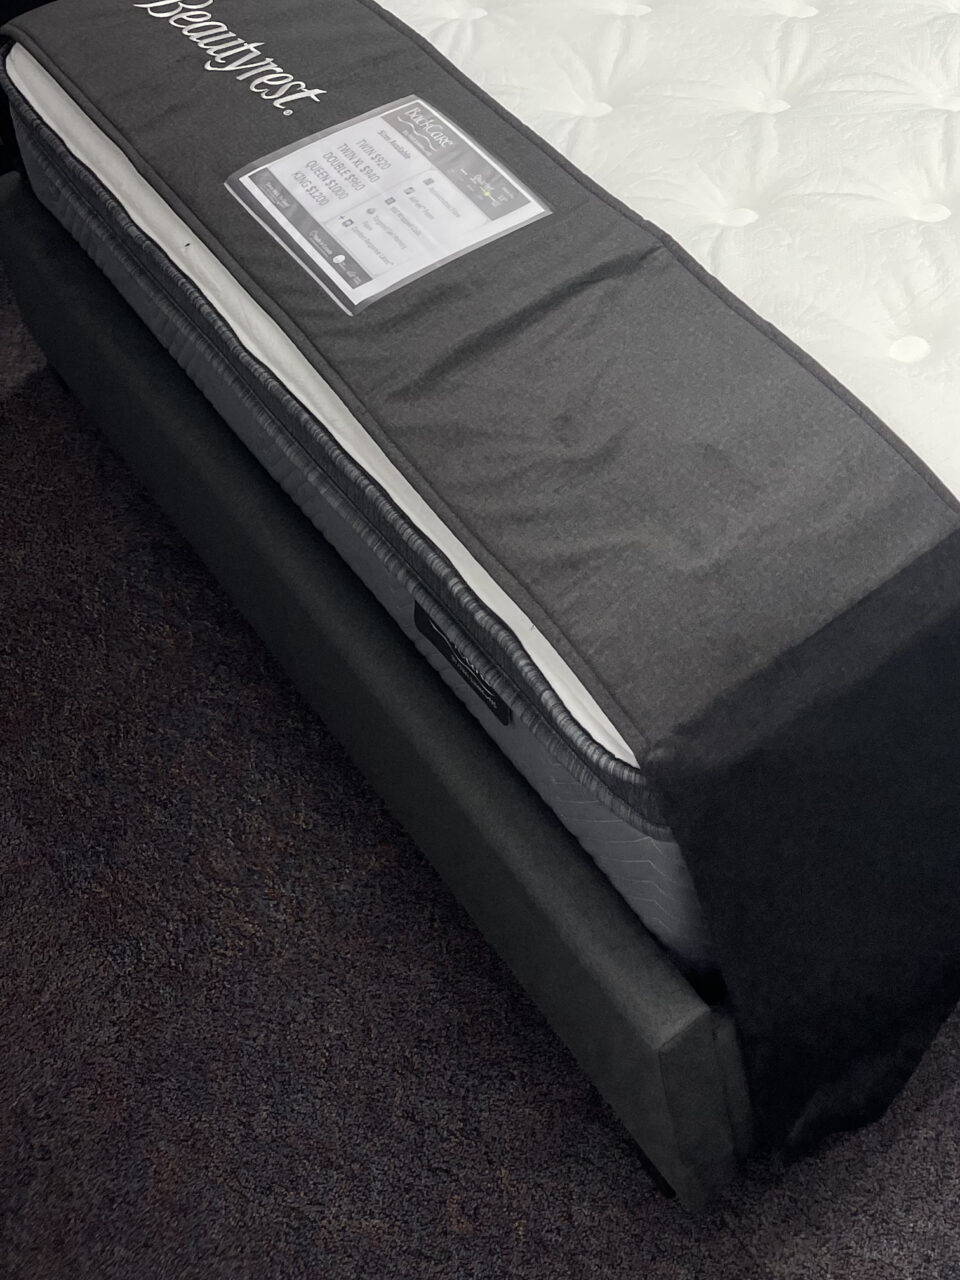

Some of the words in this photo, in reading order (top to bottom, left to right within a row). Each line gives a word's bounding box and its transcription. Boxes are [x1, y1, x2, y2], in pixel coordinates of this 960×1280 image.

[322, 151, 351, 177] DOUBLE
[344, 173, 366, 191] $960
[337, 143, 355, 161] TWIN
[352, 158, 364, 169] XL
[360, 165, 381, 183] $940
[356, 139, 377, 156] TWIN
[371, 153, 392, 170] $920
[291, 171, 312, 188] KING
[306, 186, 330, 206] $1200
[305, 160, 331, 182] QUEEN
[325, 179, 349, 200] $1000
